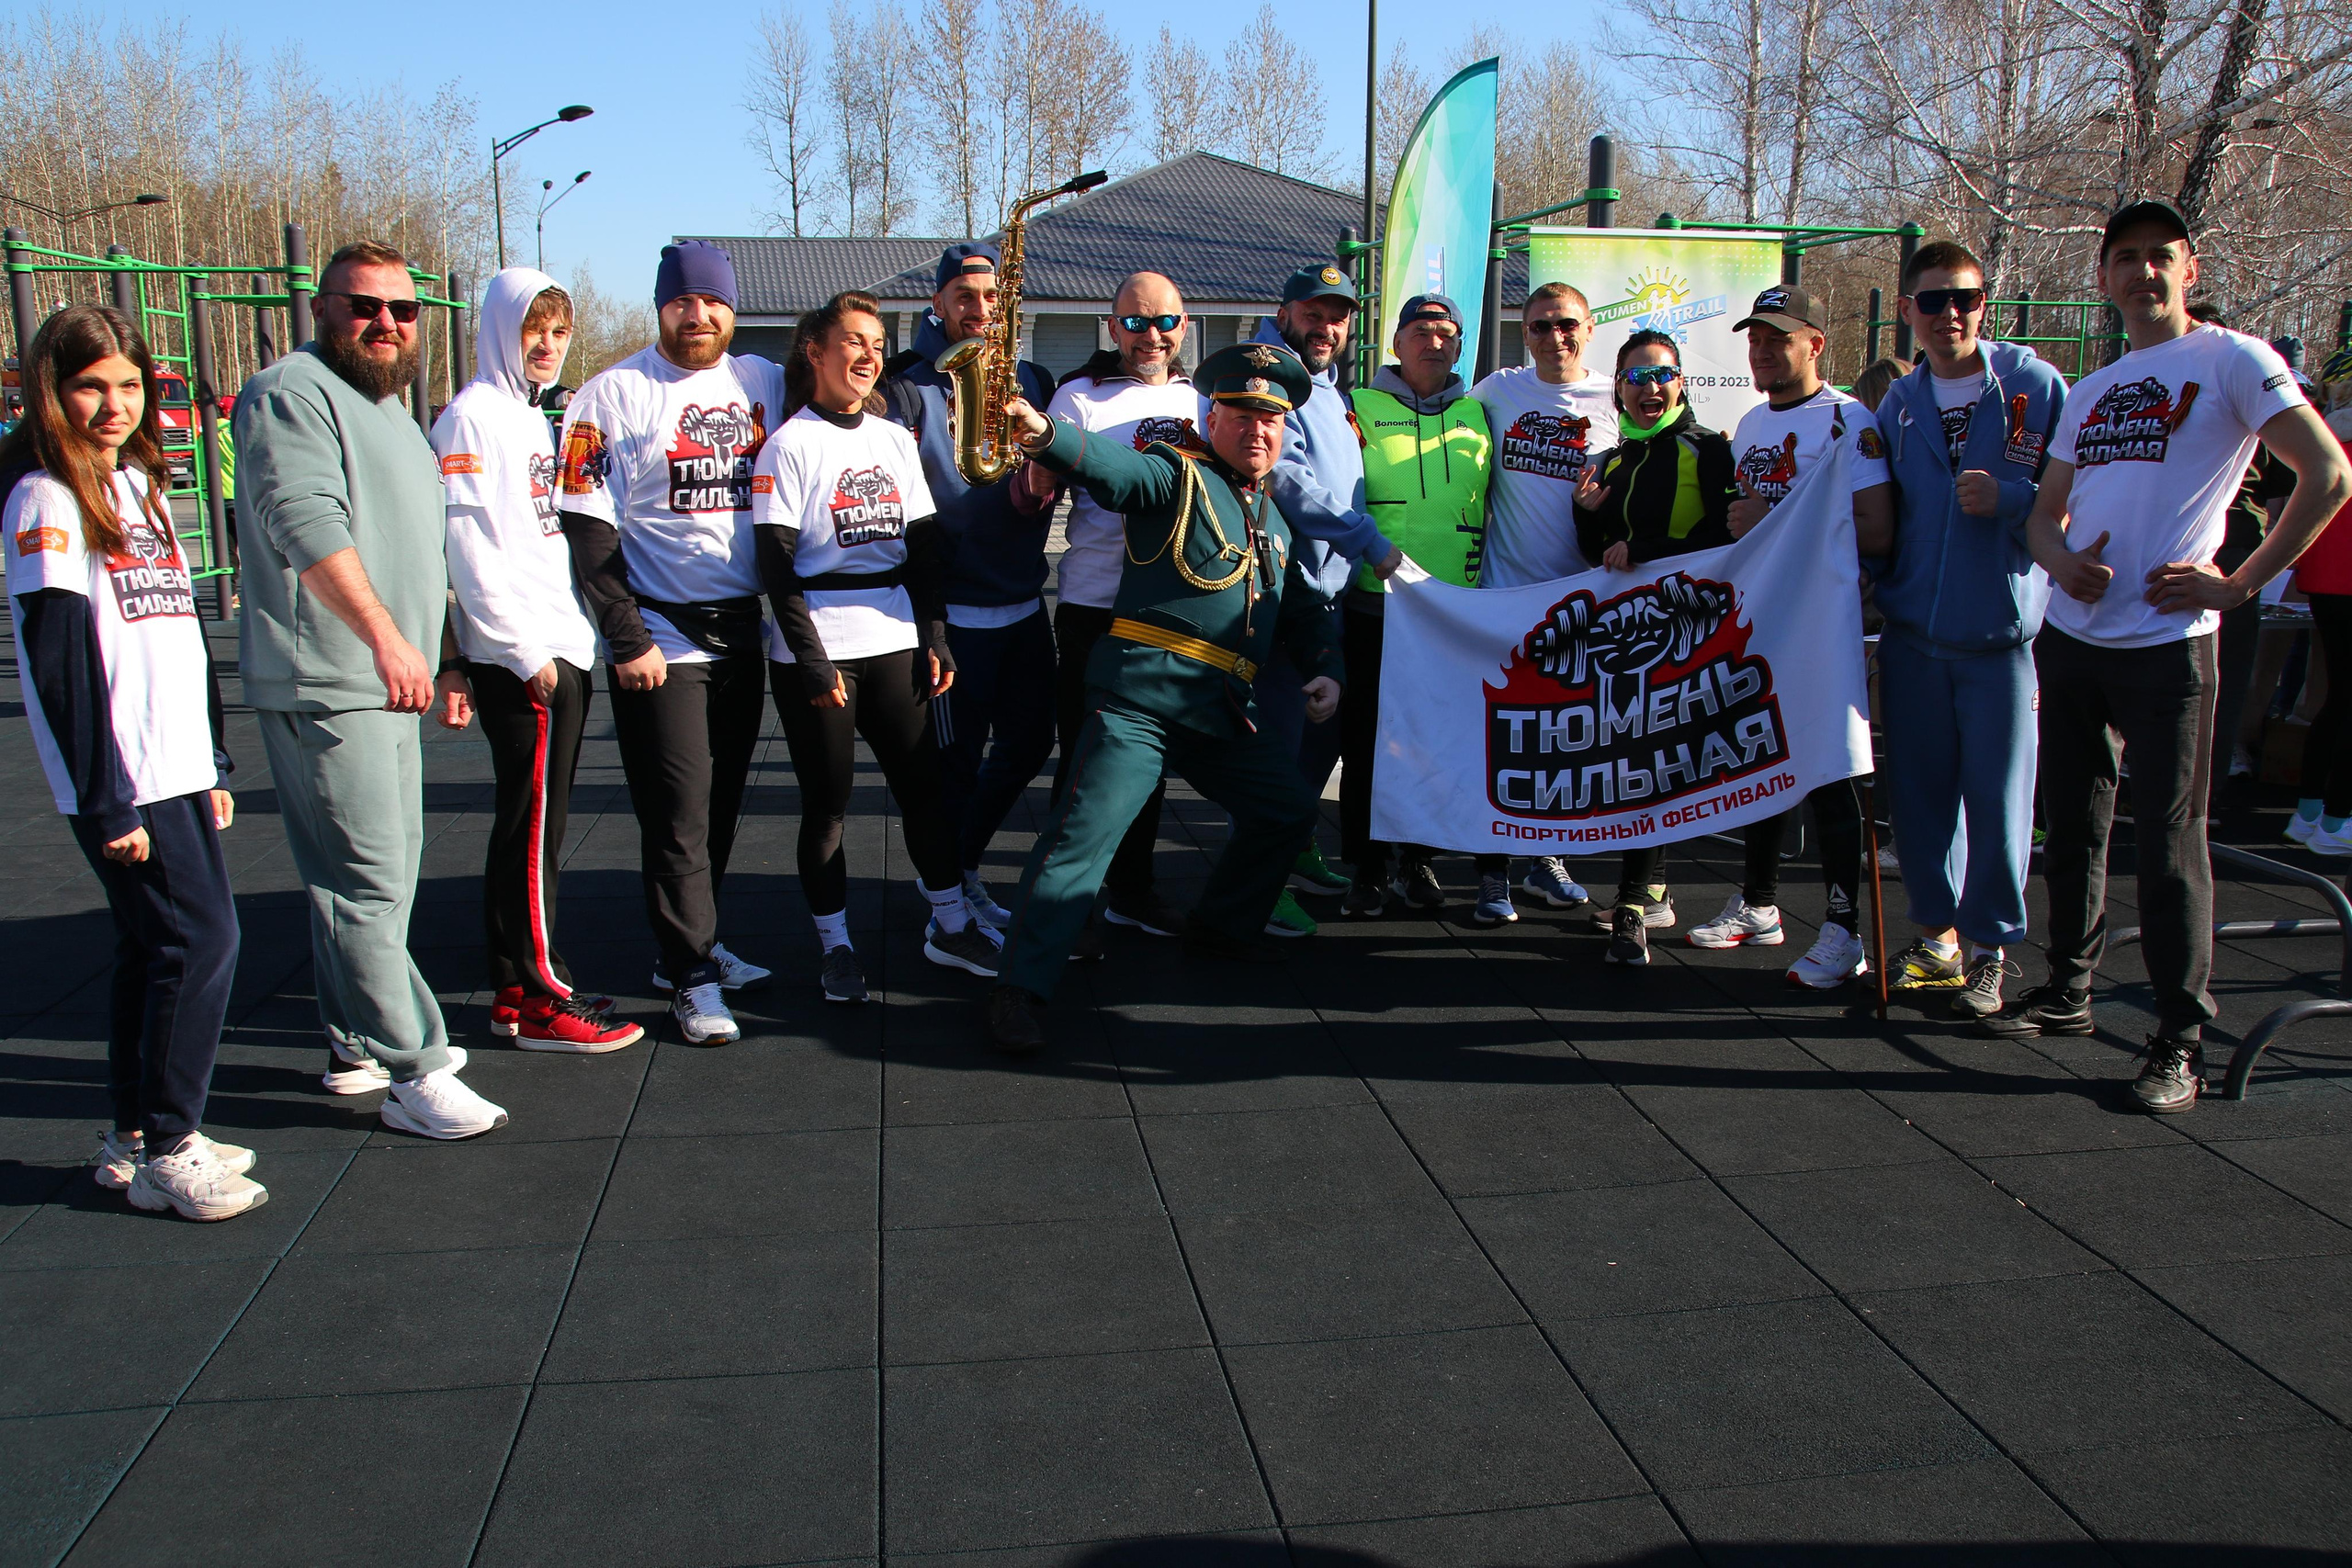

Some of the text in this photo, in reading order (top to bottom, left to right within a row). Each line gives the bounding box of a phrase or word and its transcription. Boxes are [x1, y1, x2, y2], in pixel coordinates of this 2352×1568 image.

[1593, 298, 1724, 323] TYUMEN TRAIL
[1761, 293, 1784, 304] Z
[1683, 376, 1750, 387] ЕГОВ 2023
[2266, 375, 2287, 389] AUTO
[1687, 393, 1711, 403] AIL»
[2079, 418, 2166, 443] ТЮМЕНЬ
[1506, 436, 1585, 464] ТЮМЕНЬ
[2076, 441, 2164, 466] СИЛЬНАЯ
[673, 457, 754, 482] ТЮМЕН
[1504, 455, 1580, 480] СИЛЬНАЯ
[673, 486, 752, 509] СИЛЬН
[1736, 482, 1789, 497] ЕНЬ
[834, 502, 902, 525] ТЮМЕН
[25, 535, 44, 547] SMAR
[839, 522, 901, 546] СИЛЬНА
[1497, 660, 1762, 754] ТЮМЕНЬ
[1497, 709, 1780, 811] СИЛЬНАЯ
[1491, 772, 1796, 842] СПОРТИВНЫЙ ФЕСТИВАЛЬ
